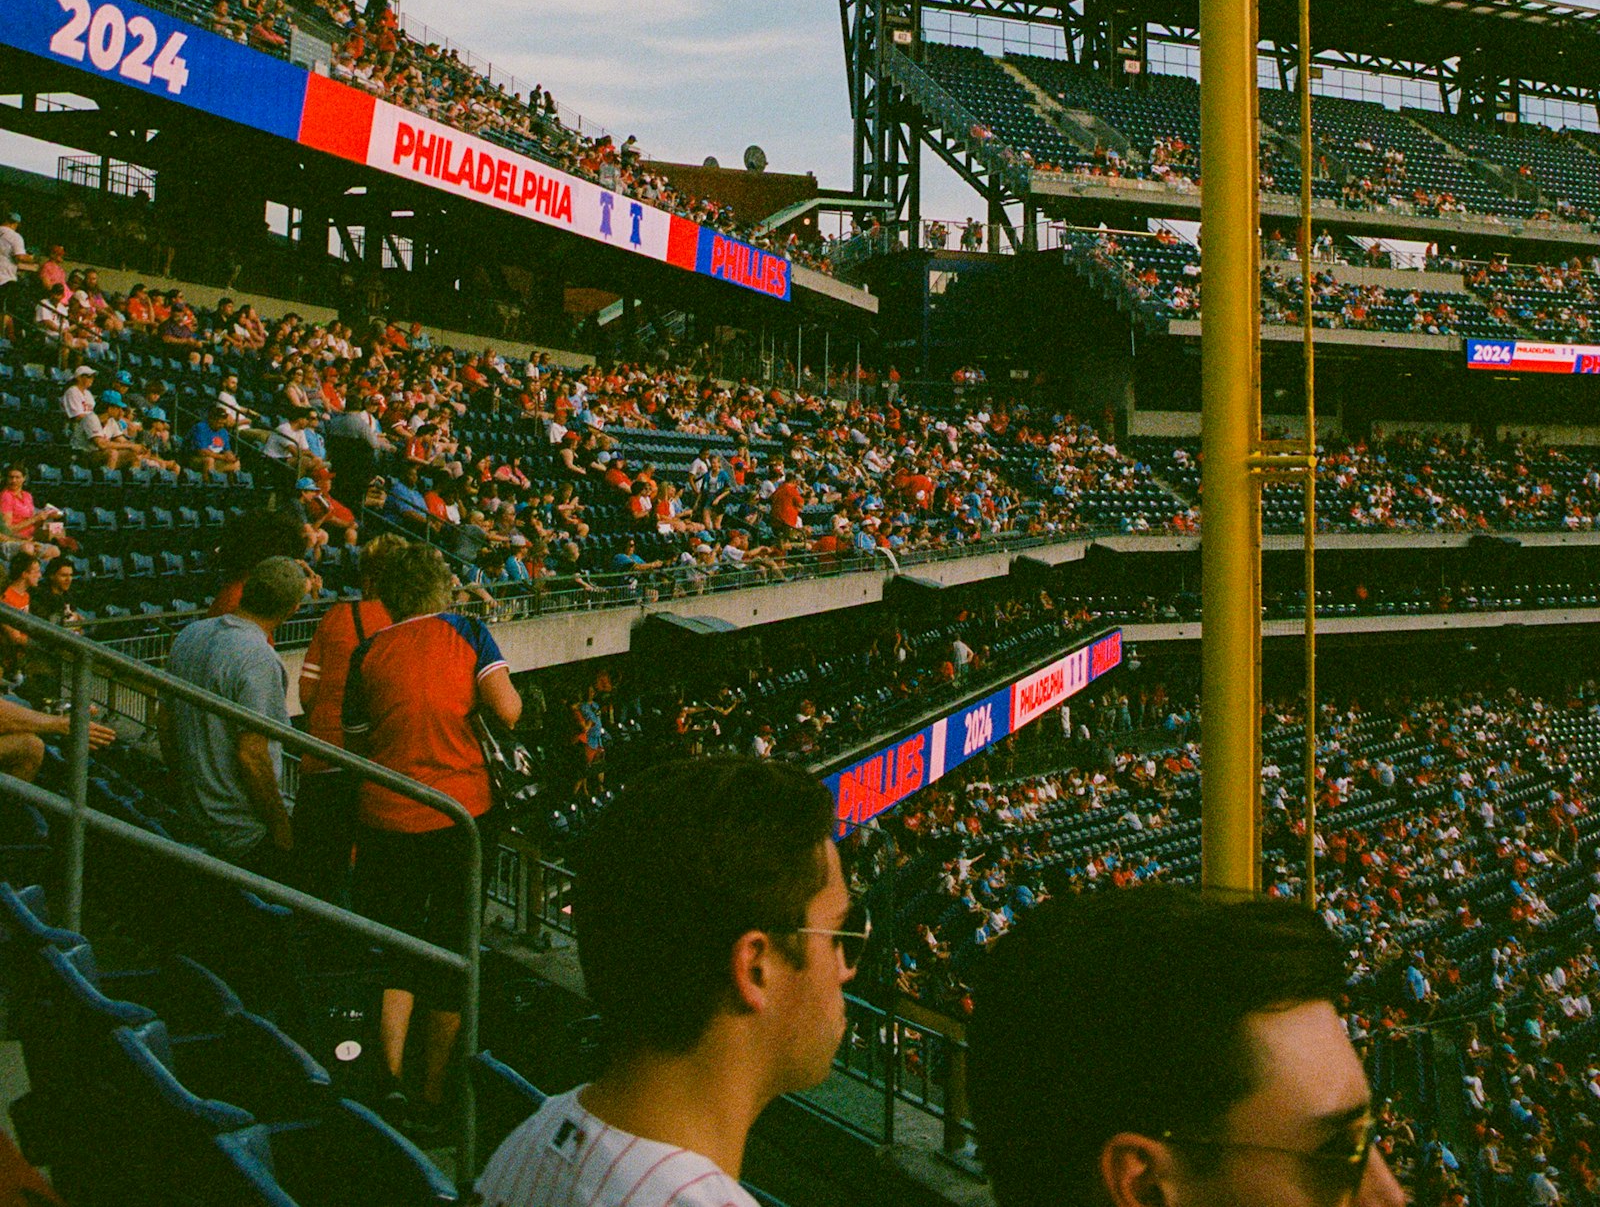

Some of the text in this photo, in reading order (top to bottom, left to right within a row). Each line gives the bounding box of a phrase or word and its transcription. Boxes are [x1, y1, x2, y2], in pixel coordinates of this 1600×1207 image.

[393, 122, 573, 224] PHILADELPHIA
[710, 234, 787, 298] PHILLIES
[1473, 344, 1511, 363] 2024
[1092, 632, 1121, 679] PHILLIES
[1020, 669, 1064, 718] PHILADELPHIA
[963, 702, 993, 757] 2024
[837, 733, 925, 837] PHILLIES
